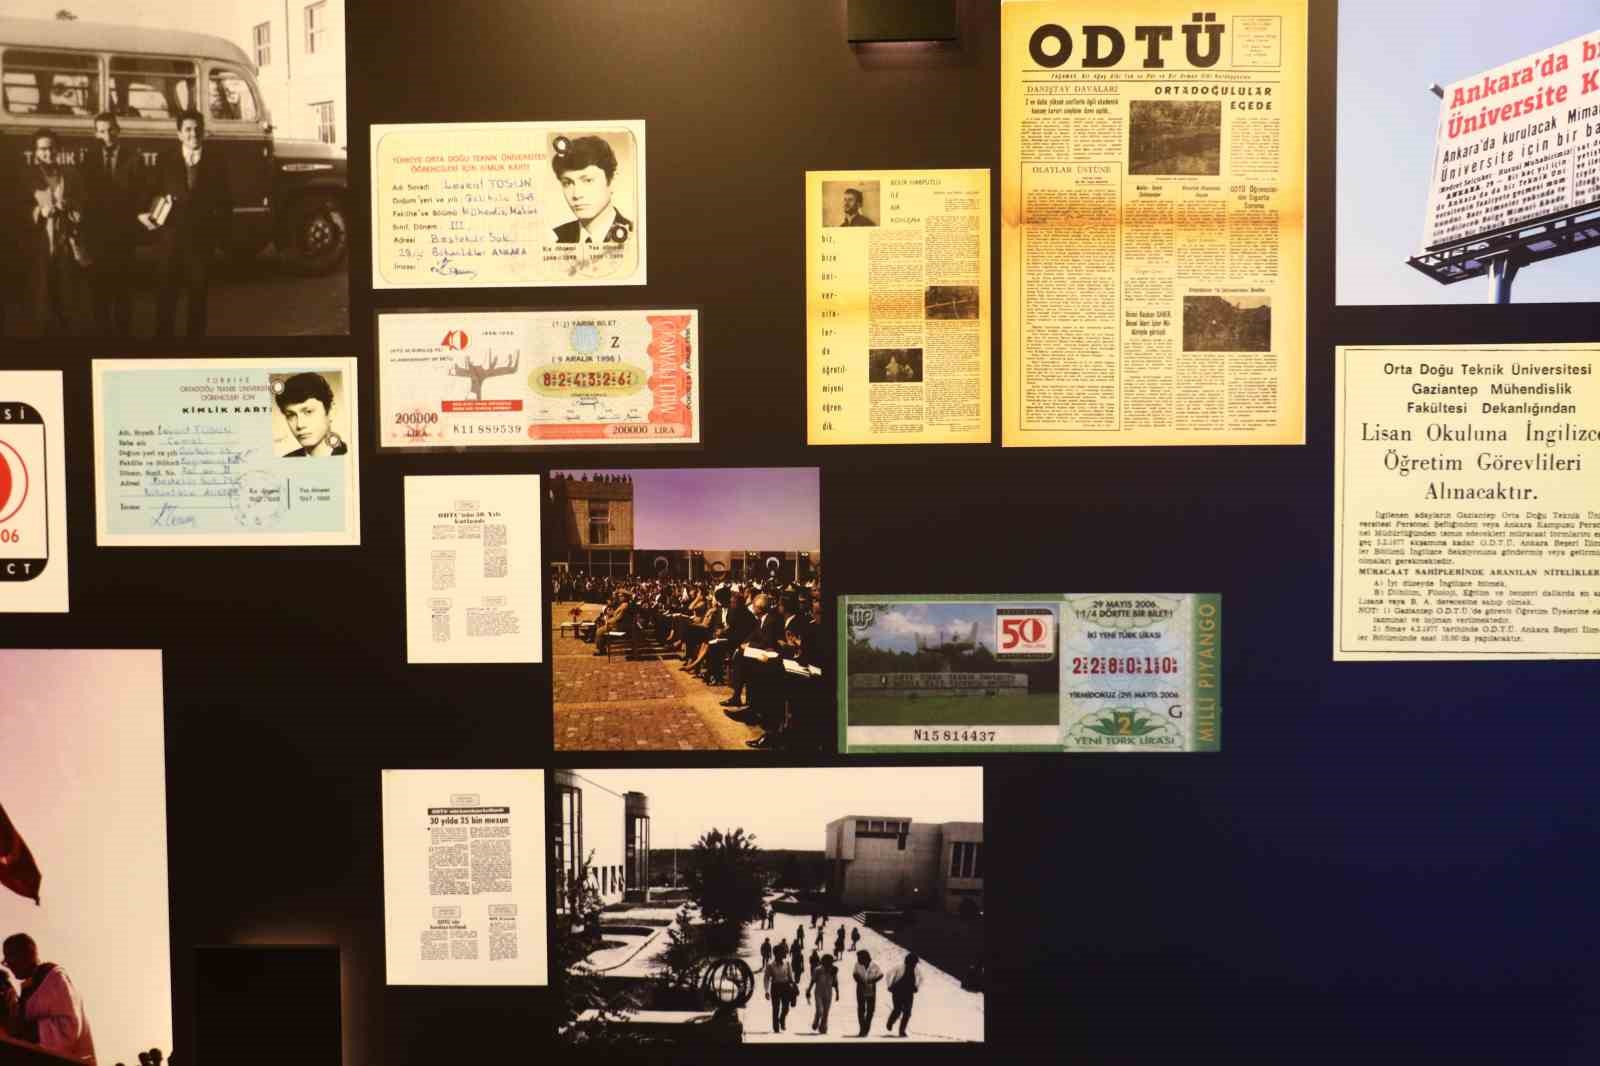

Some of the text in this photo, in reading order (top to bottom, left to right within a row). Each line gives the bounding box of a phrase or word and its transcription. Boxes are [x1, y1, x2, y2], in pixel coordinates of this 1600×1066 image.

[1029, 12, 1225, 68] ODTÜ
[1450, 52, 1569, 110] Ankara'da
[1154, 86, 1272, 96] ORTADOĞULULAR
[1230, 101, 1272, 110] EGEDE
[1447, 84, 1568, 139] Üniversite
[1442, 104, 1600, 165] Ankara'da kurulacak Mima
[1441, 150, 1514, 183] Üniversite
[1557, 129, 1577, 147] bir
[610, 336, 620, 349] Z
[1384, 361, 1592, 378] Orta Doğu Teknik Üniversitesi
[1411, 382, 1572, 398] Gaziantep Mühendislik
[182, 405, 228, 414] KİMLİK
[1407, 402, 1576, 417] Fakültesi Dekanlığından
[1361, 422, 1412, 442] Lisan
[1426, 422, 1508, 442] Okuluna
[1384, 449, 1582, 477] Öğretim Görevlileri
[1424, 481, 1539, 501] Alınacaktır.
[1099, 608, 1131, 618] DÖRTTE
[1132, 608, 1146, 618] BİR
[1105, 600, 1133, 609] MAYIS
[1002, 618, 1044, 649] 50
[1099, 630, 1117, 640] YENİ
[1118, 630, 1137, 640] TÜRK
[1199, 603, 1217, 689] PİYANGO
[1168, 704, 1183, 719] G
[1199, 697, 1217, 742] MİLLİ
[913, 728, 996, 742] N15 814437
[1119, 717, 1131, 736] 2
[1074, 736, 1175, 745] YENİ TÜRK LİRASI
